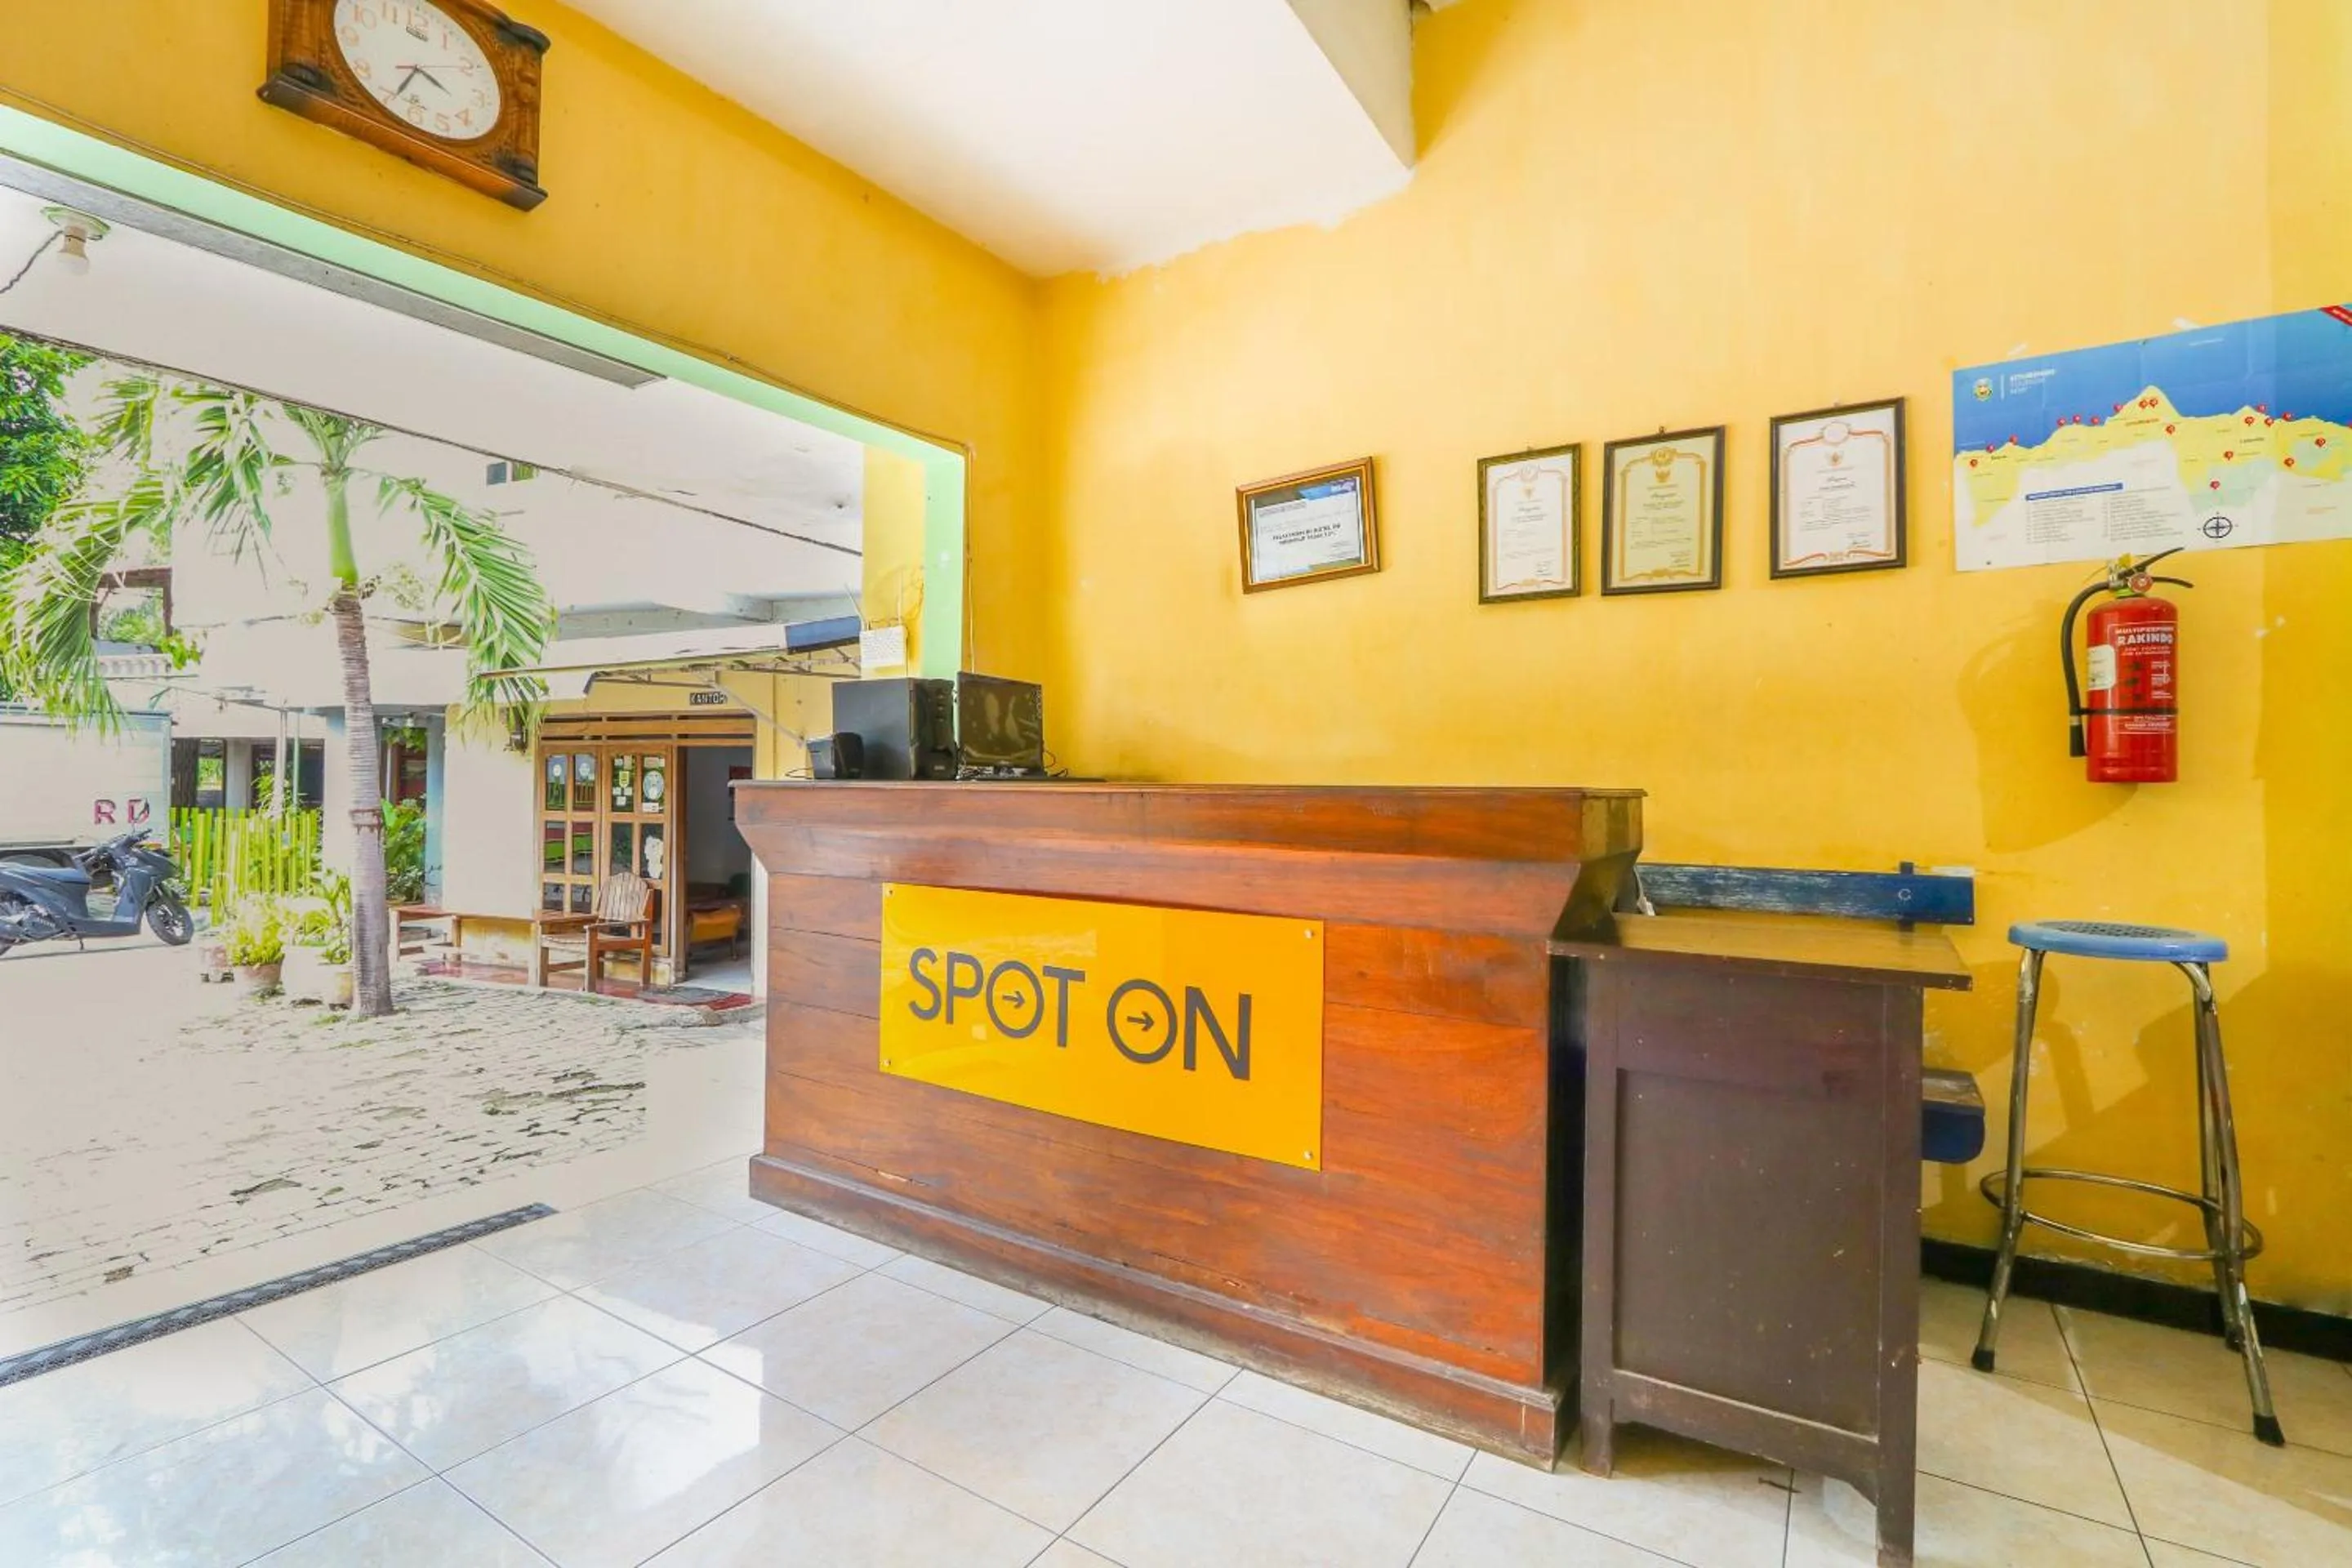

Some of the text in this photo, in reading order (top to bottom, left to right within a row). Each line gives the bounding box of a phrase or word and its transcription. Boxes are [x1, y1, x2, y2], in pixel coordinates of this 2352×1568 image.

[354, 4, 376, 30] 10
[382, 2, 398, 24] 11
[408, 7, 429, 29] 12
[341, 25, 359, 47] 9
[354, 57, 372, 78] 8
[459, 56, 474, 77] 2
[378, 85, 398, 105] 7
[471, 88, 485, 108] 3
[435, 112, 450, 131] 5
[455, 108, 472, 127] 4
[908, 947, 1252, 1080] SPOT ON
